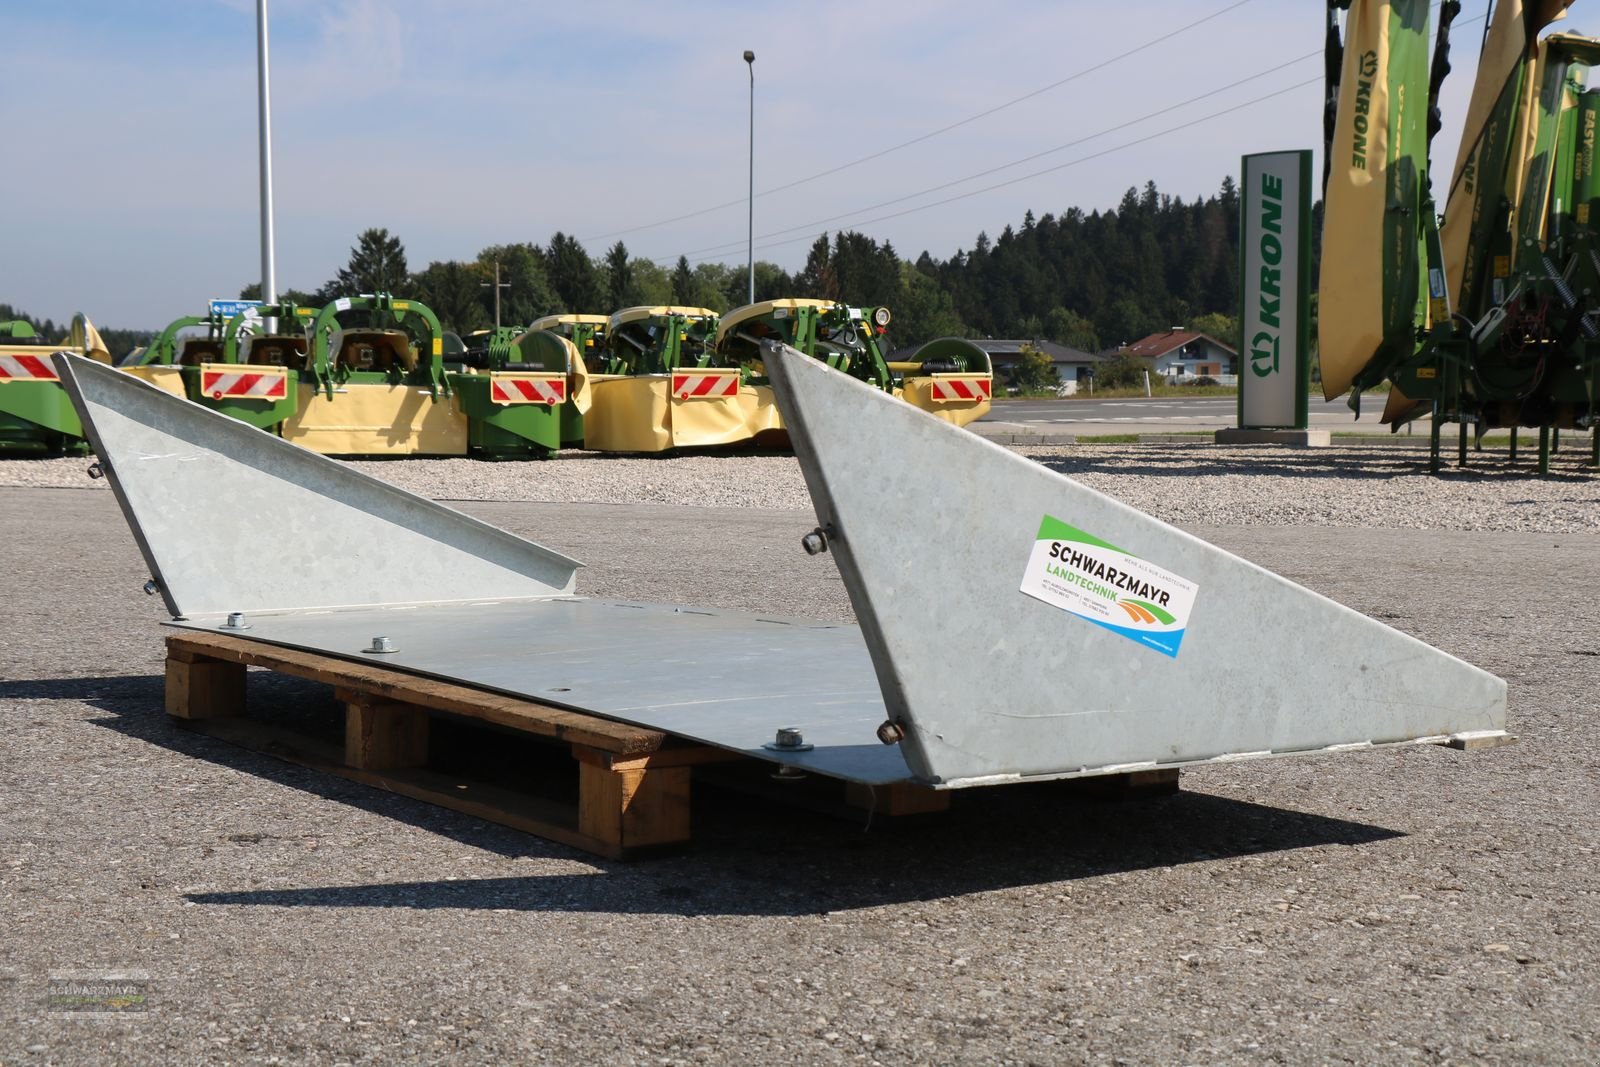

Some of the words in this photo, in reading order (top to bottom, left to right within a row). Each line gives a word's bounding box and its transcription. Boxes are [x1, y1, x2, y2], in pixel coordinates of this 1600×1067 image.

[1352, 80, 1371, 170] KRONE
[1260, 172, 1282, 329] KRONE
[1046, 562, 1118, 602] LANDTECHNIK
[1049, 541, 1170, 607] SCHWARZMAYR
